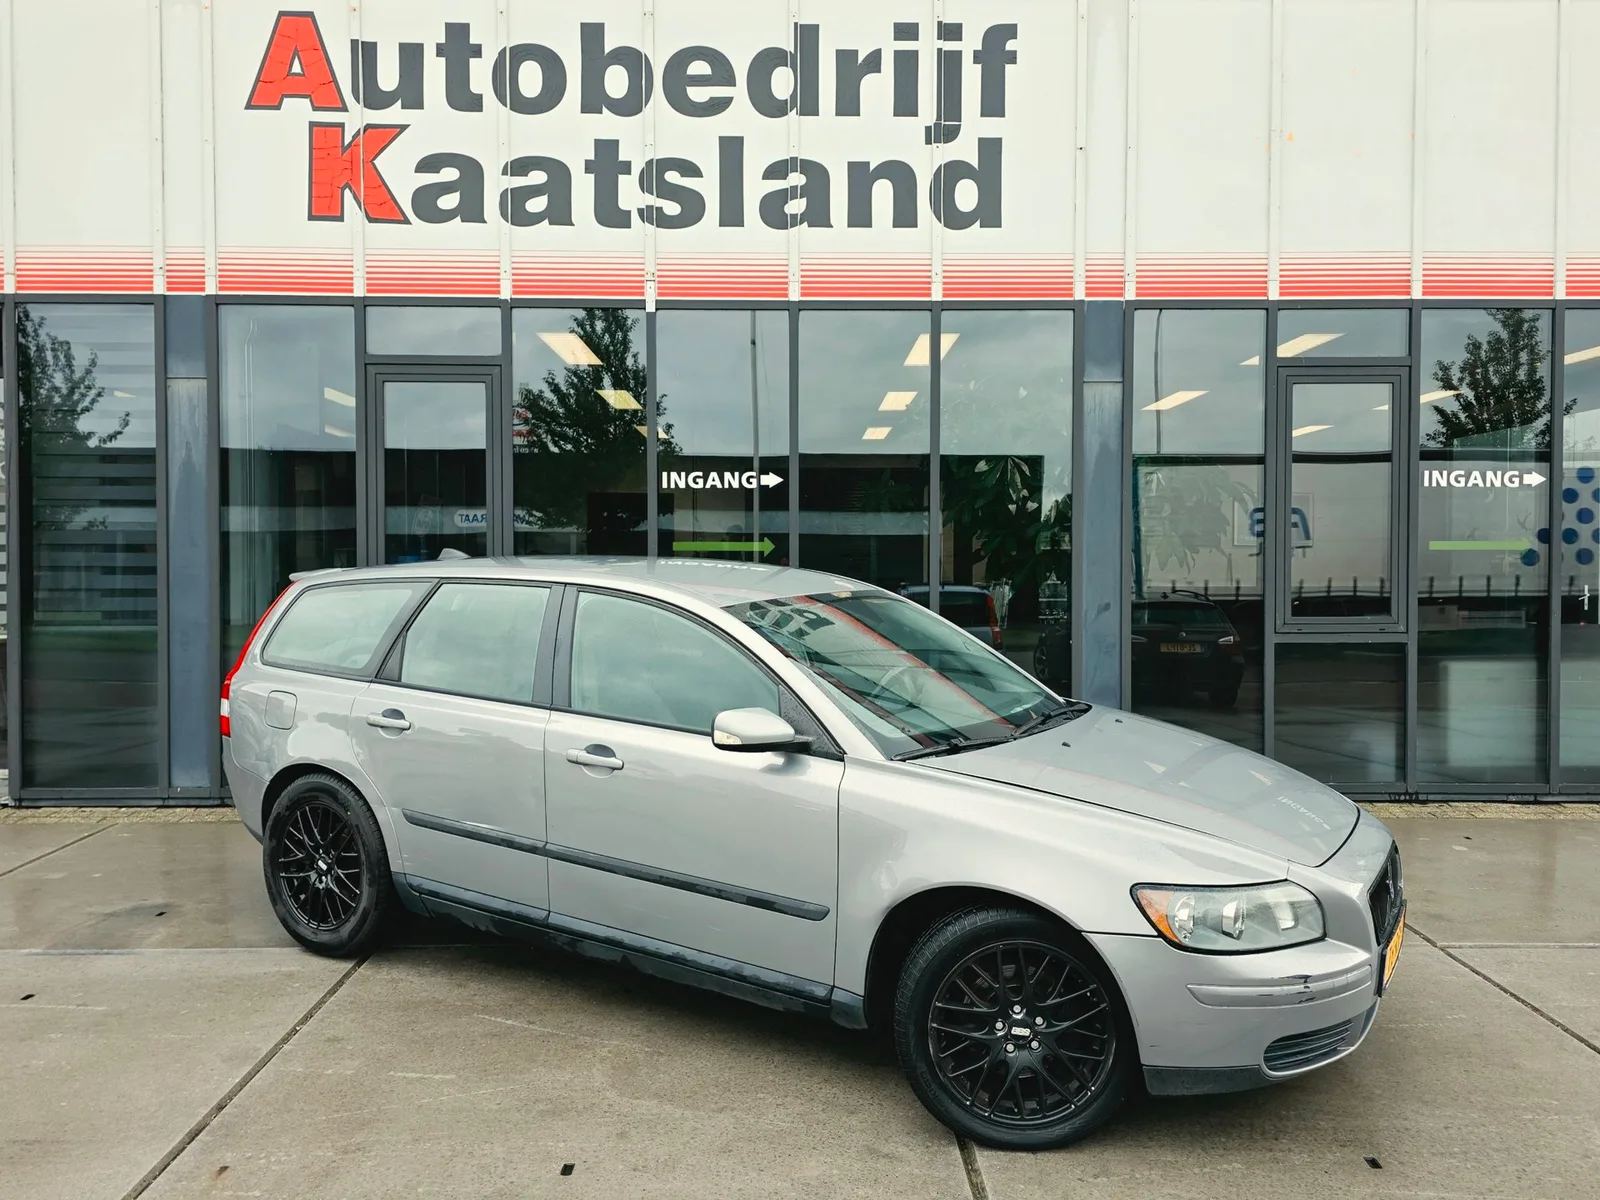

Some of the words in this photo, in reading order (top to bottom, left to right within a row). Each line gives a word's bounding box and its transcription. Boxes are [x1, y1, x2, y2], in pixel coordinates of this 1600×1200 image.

[244, 11, 1018, 145] Autobedrijf
[308, 121, 1003, 230] Kaatsland
[662, 471, 757, 489] INGANG
[1423, 470, 1520, 488] INGANG
